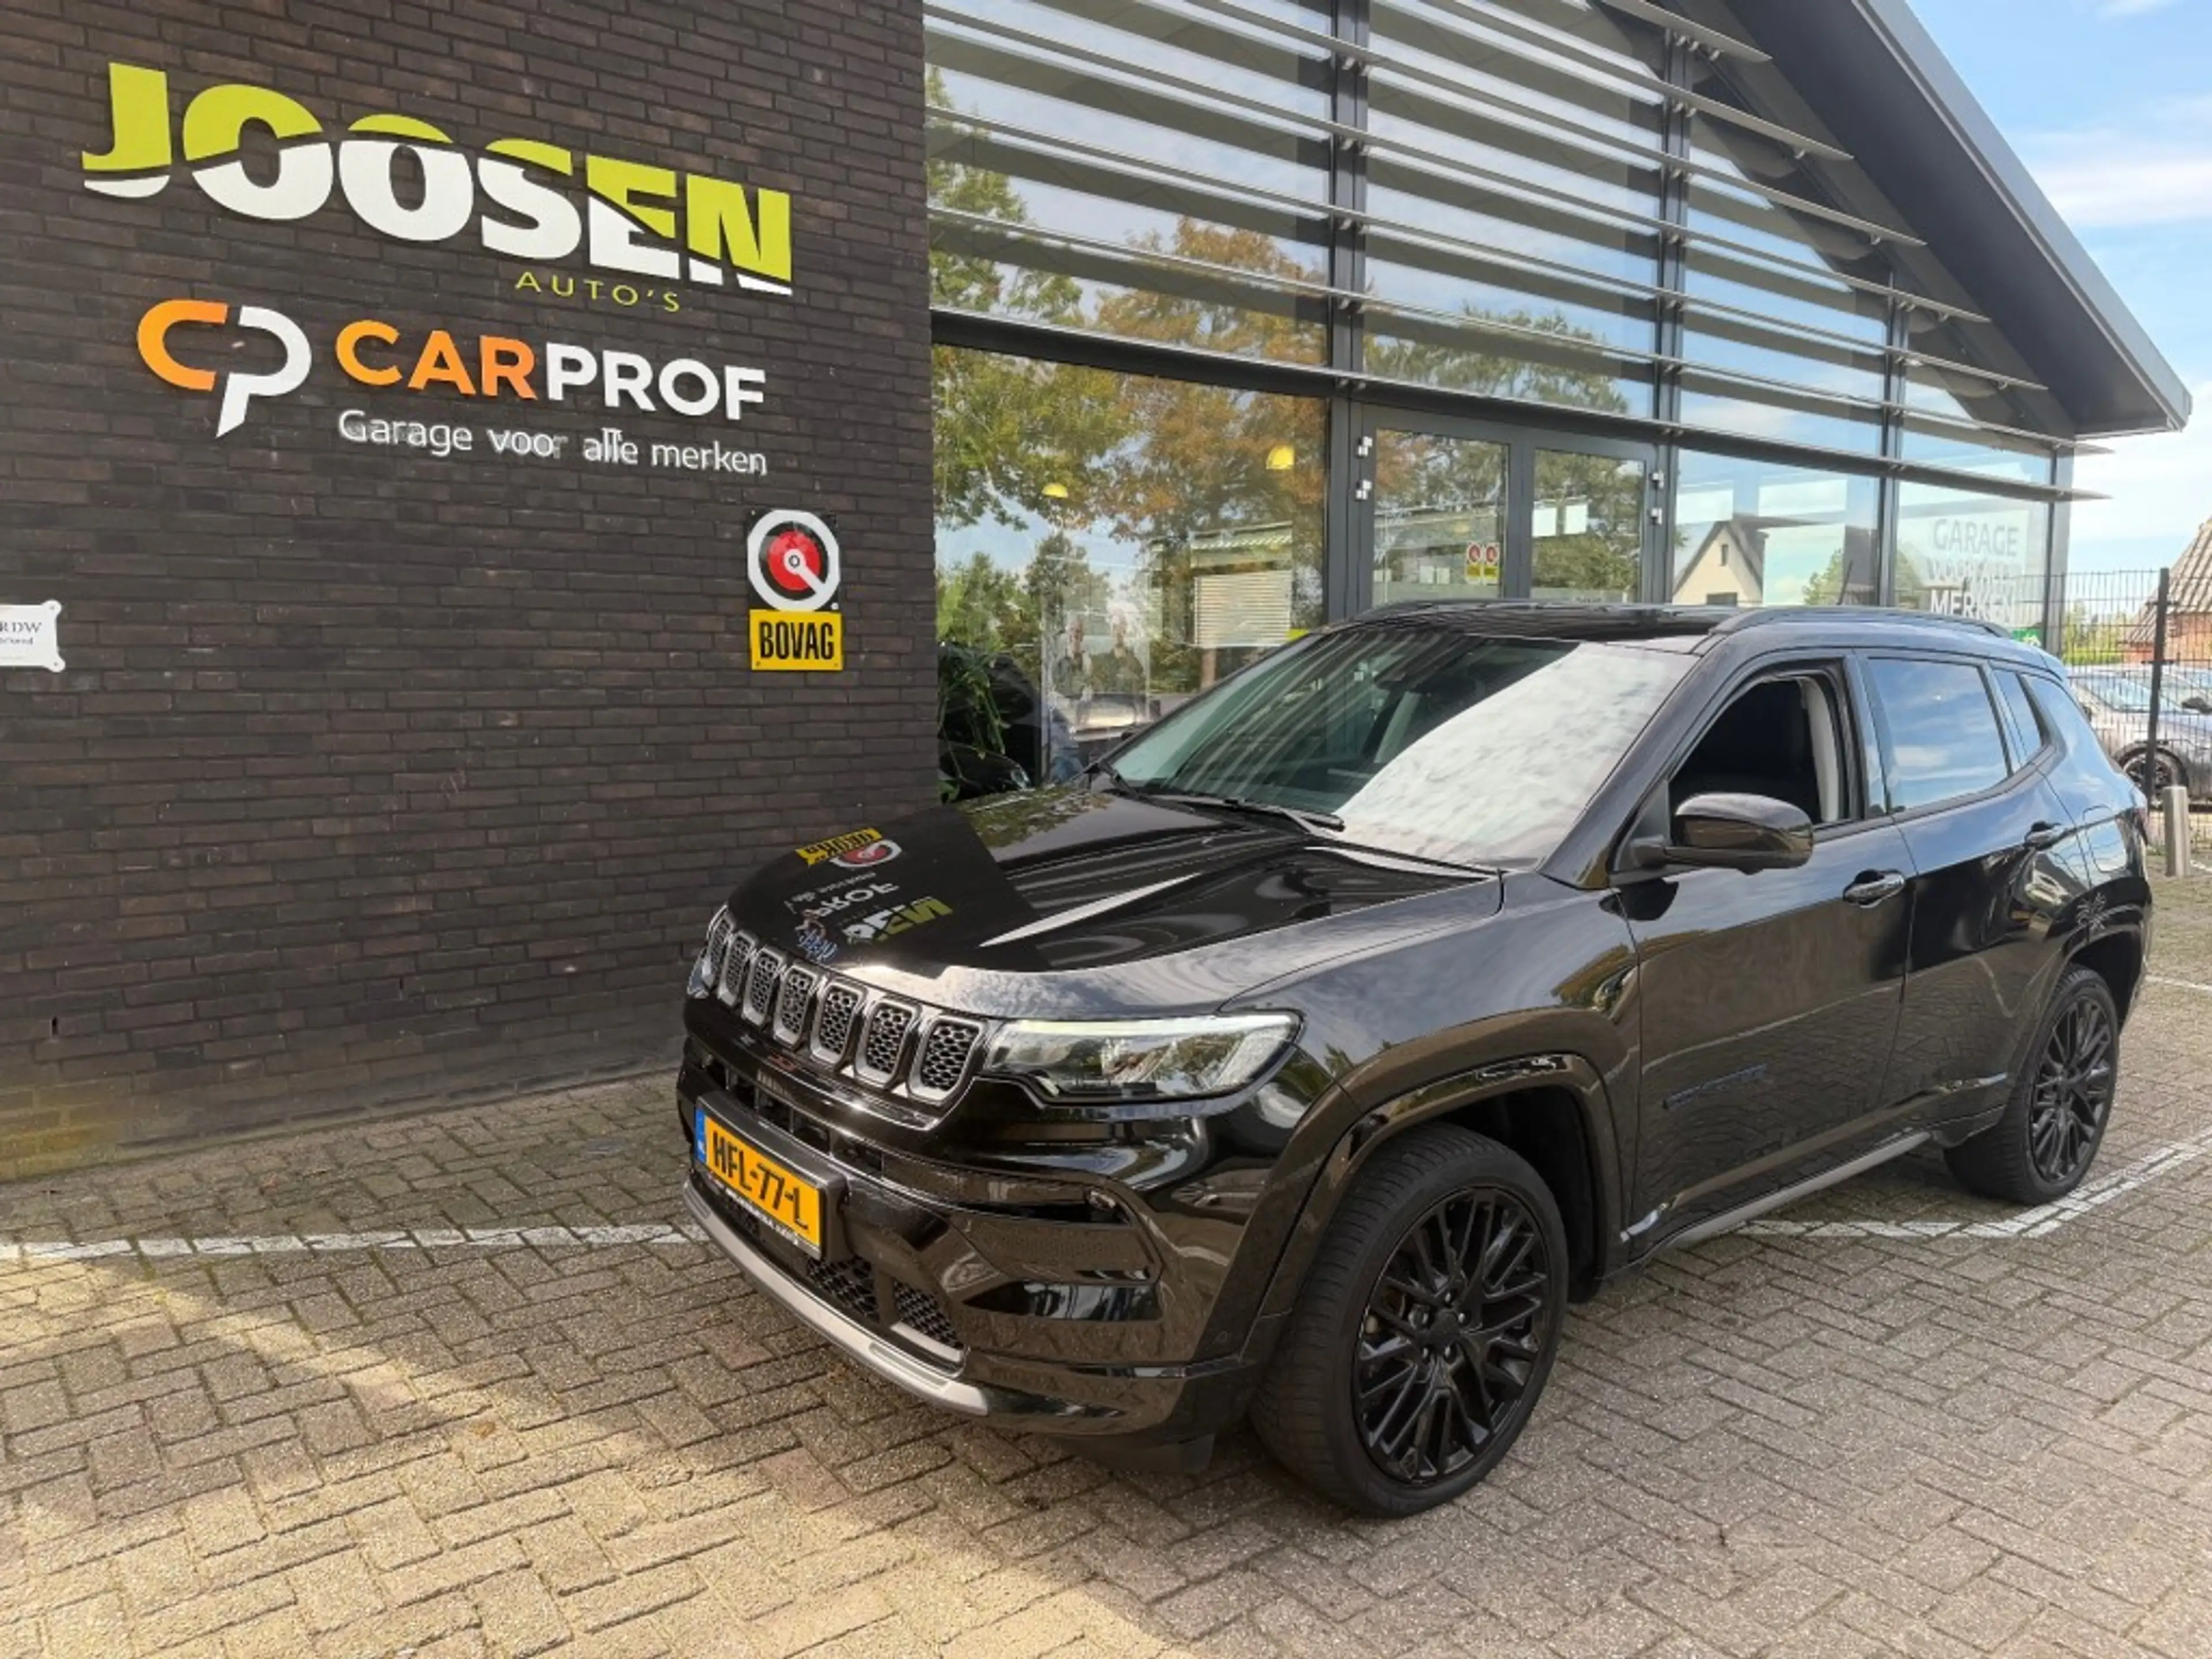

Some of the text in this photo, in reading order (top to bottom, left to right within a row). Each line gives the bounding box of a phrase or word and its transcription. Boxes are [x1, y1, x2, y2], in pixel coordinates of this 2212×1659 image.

[81, 62, 792, 296] JOOSEN
[516, 271, 680, 312] AUTO'S
[336, 319, 766, 420] CARPROF
[339, 409, 768, 476] Garage voor alle merken
[1933, 518, 2019, 556] GARAGE
[759, 622, 834, 660] BOVAG
